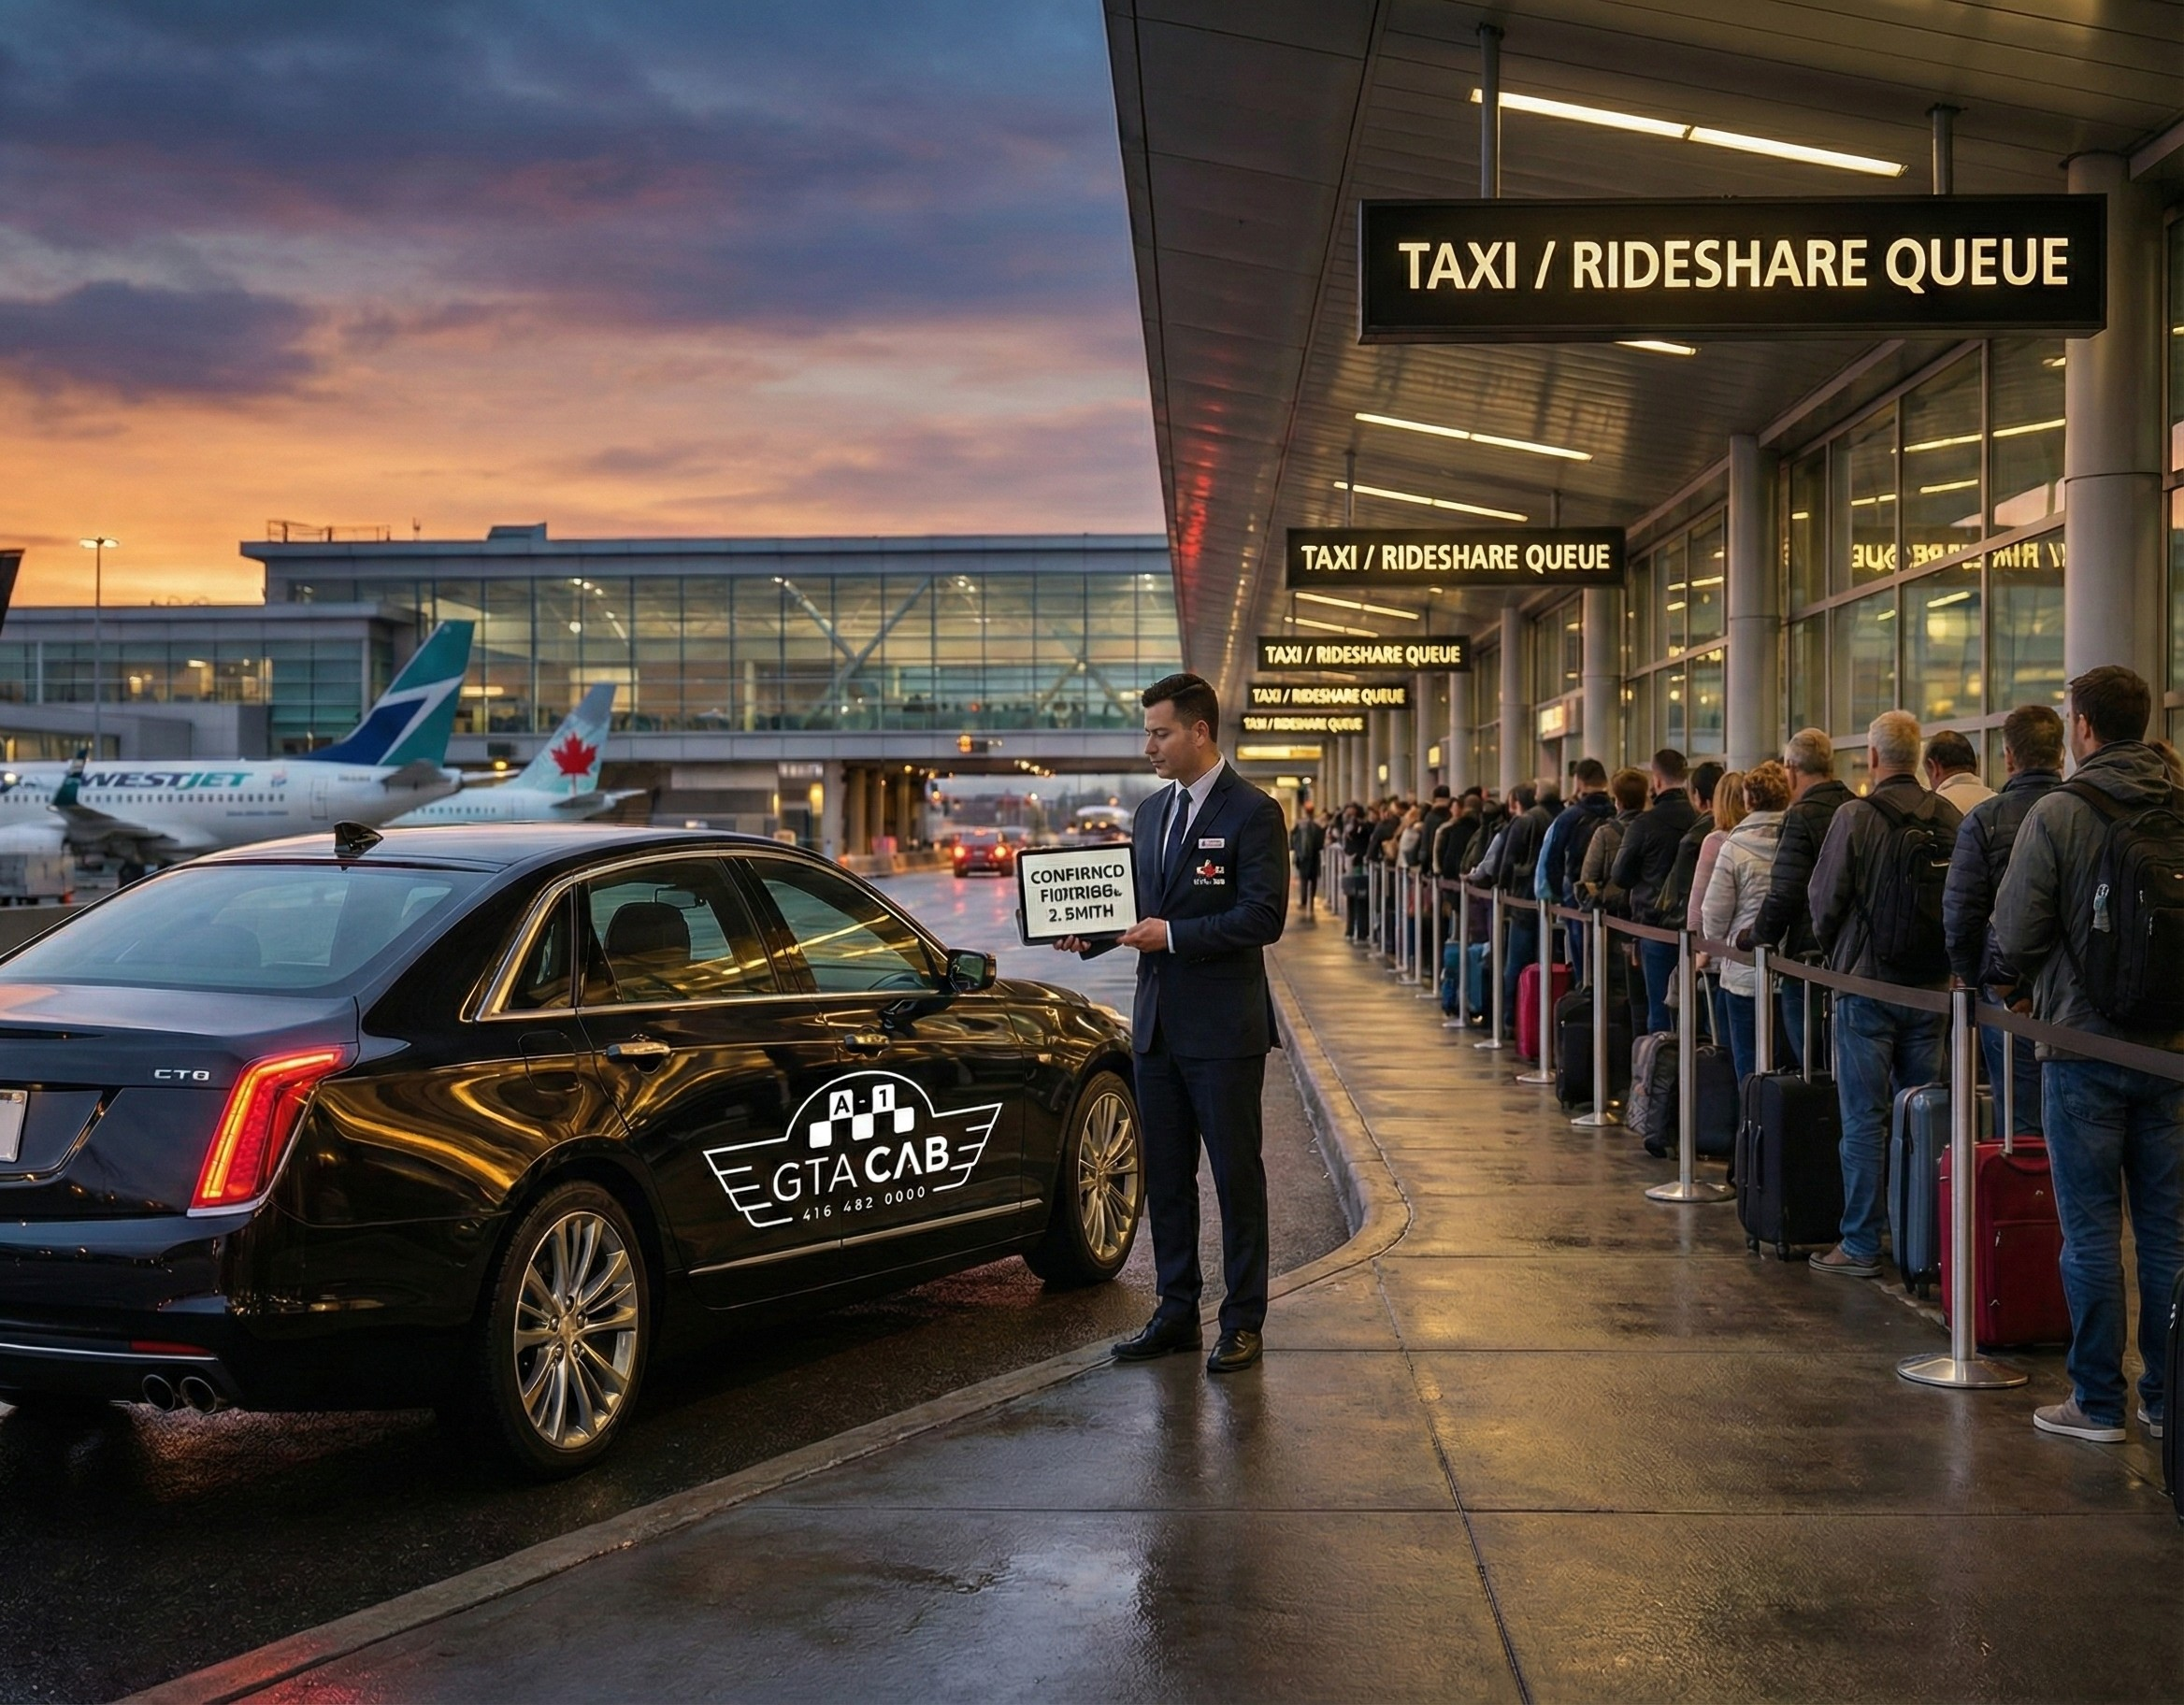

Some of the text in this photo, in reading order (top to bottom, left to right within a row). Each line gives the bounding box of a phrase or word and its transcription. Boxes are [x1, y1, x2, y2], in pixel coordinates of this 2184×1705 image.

[1398, 237, 2069, 294] TAXI / RIDESHARE QUEUE
[1300, 543, 1610, 575] TAXI / RIDESHARE QUEUE
[1265, 645, 1460, 667] TAXI / RIDESHARE QUEUE
[1252, 688, 1282, 704] TAXI
[1360, 688, 1405, 707] QUEUE
[80, 772, 253, 790] WESTJET
[802, 1185, 926, 1221] 416 482 0000
